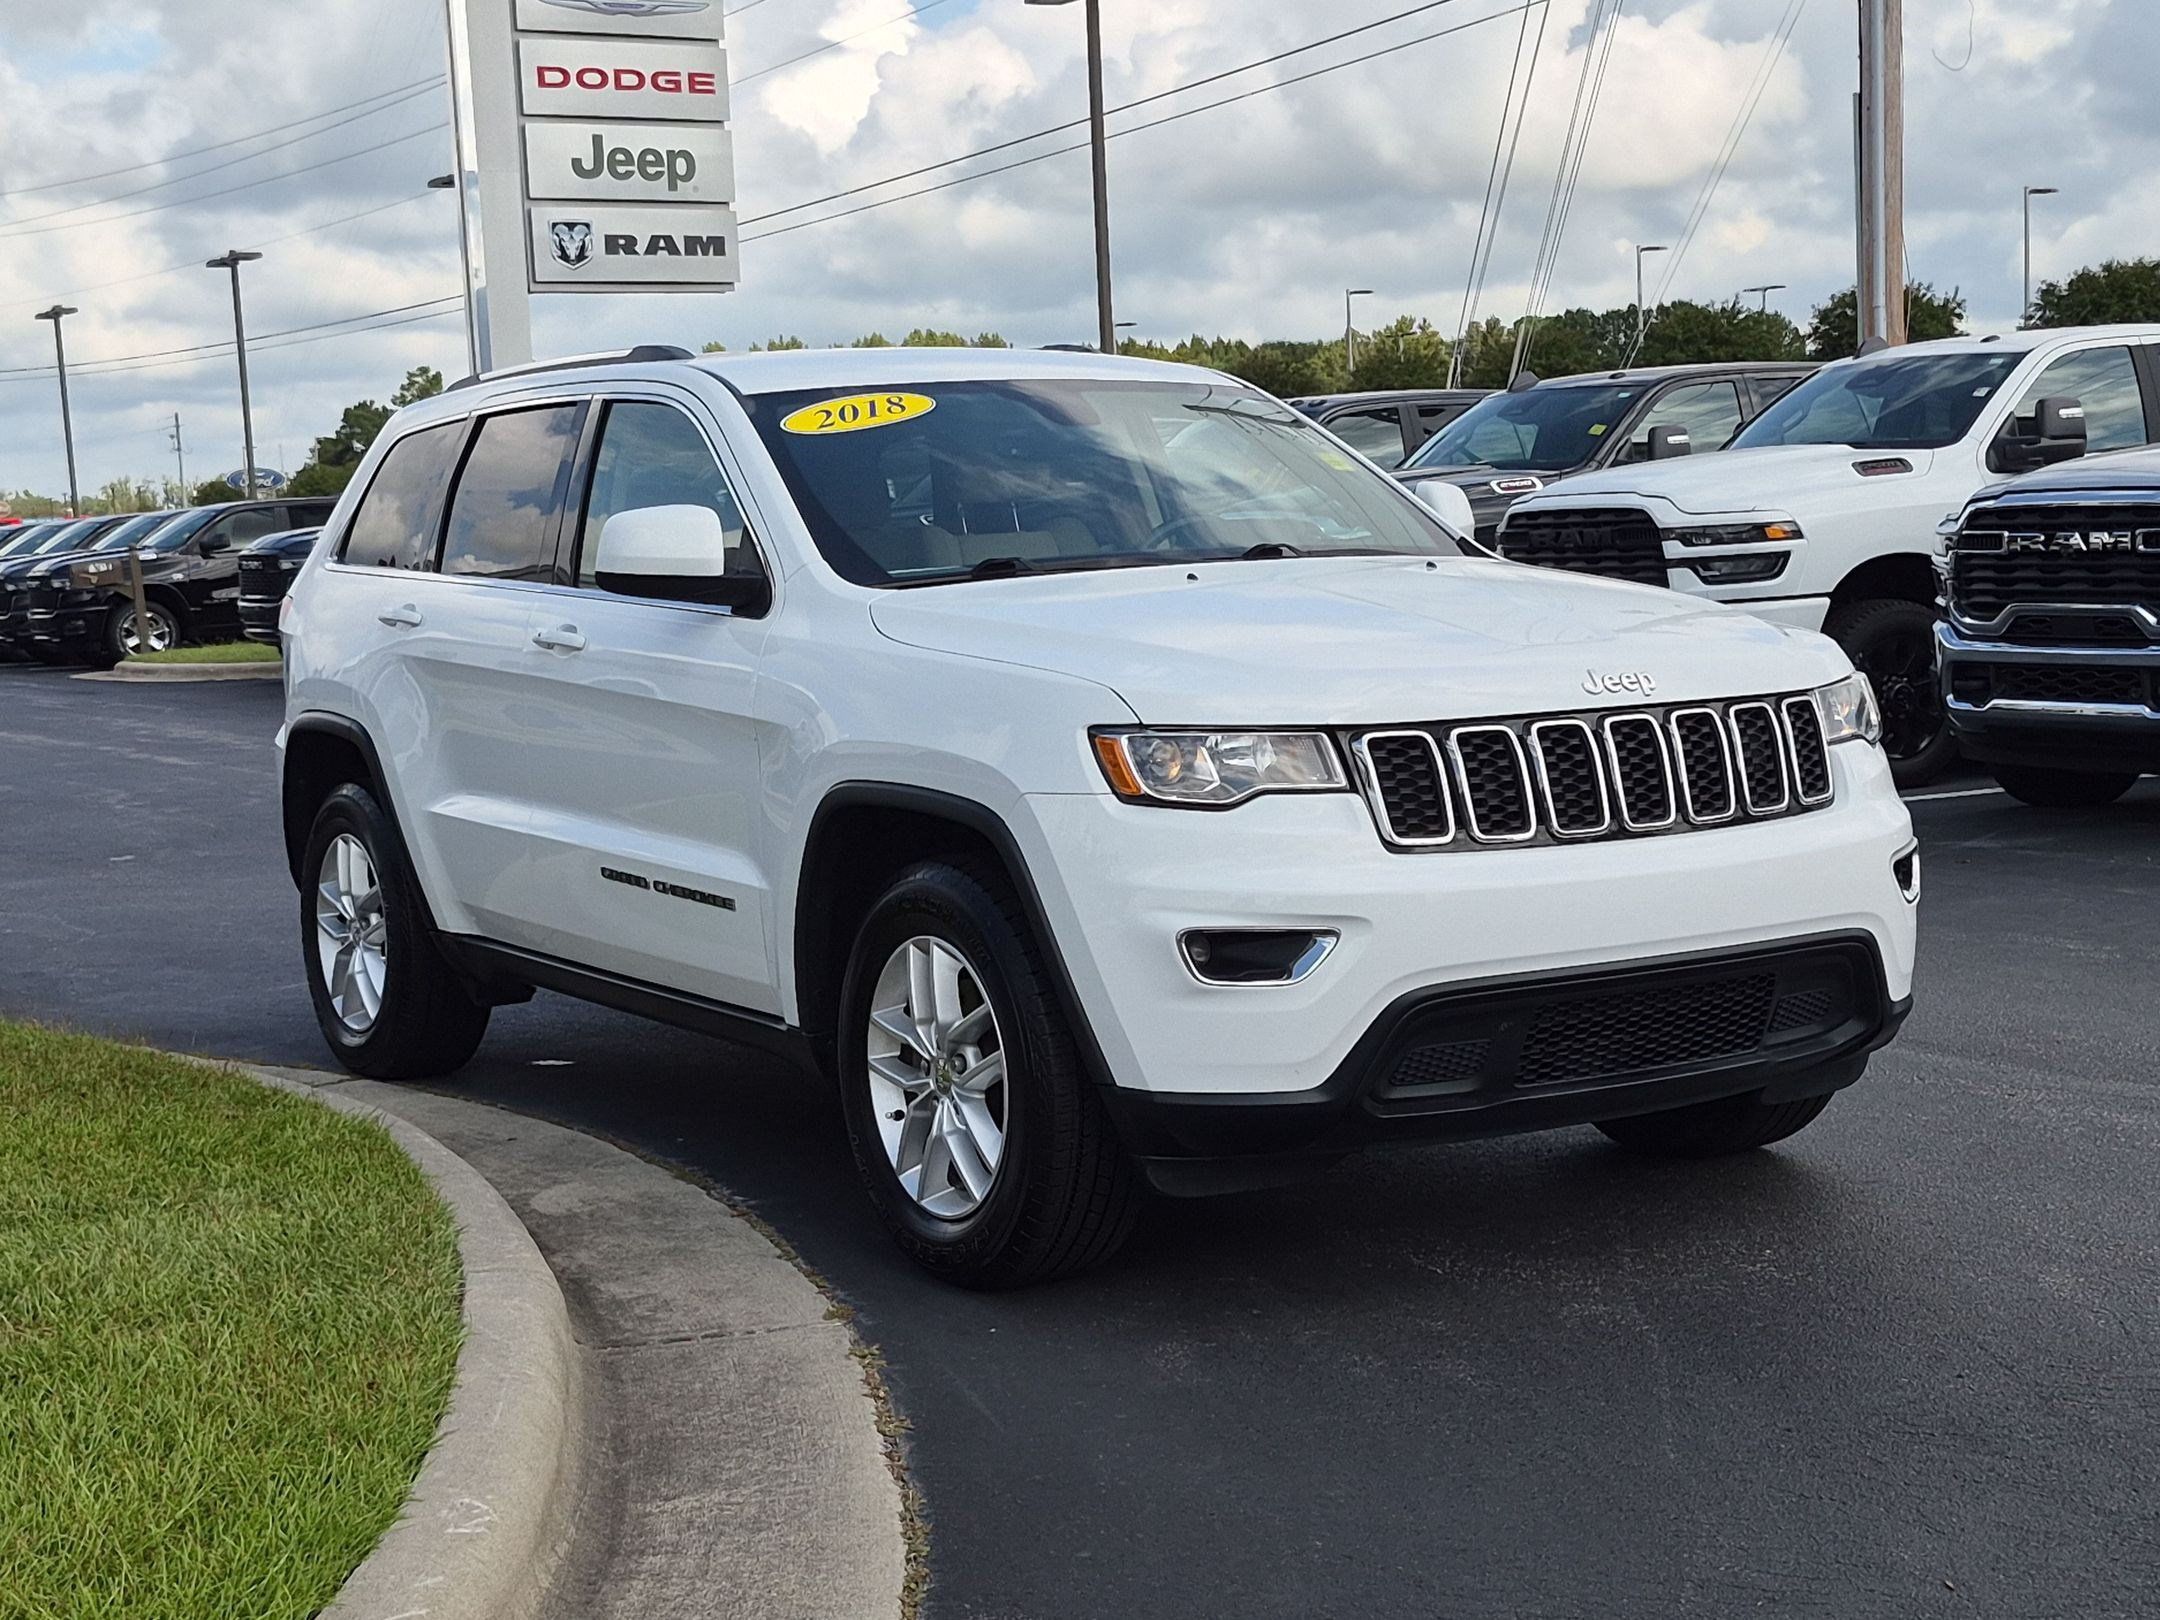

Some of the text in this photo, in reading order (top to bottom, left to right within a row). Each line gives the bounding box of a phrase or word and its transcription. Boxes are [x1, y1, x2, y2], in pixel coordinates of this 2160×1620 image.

[537, 66, 716, 95] DODGE
[571, 134, 696, 191] Jeep
[604, 234, 726, 257] RAM
[814, 395, 906, 430] 2018
[2007, 531, 2132, 551] RAM
[1581, 668, 1656, 697] Jeep
